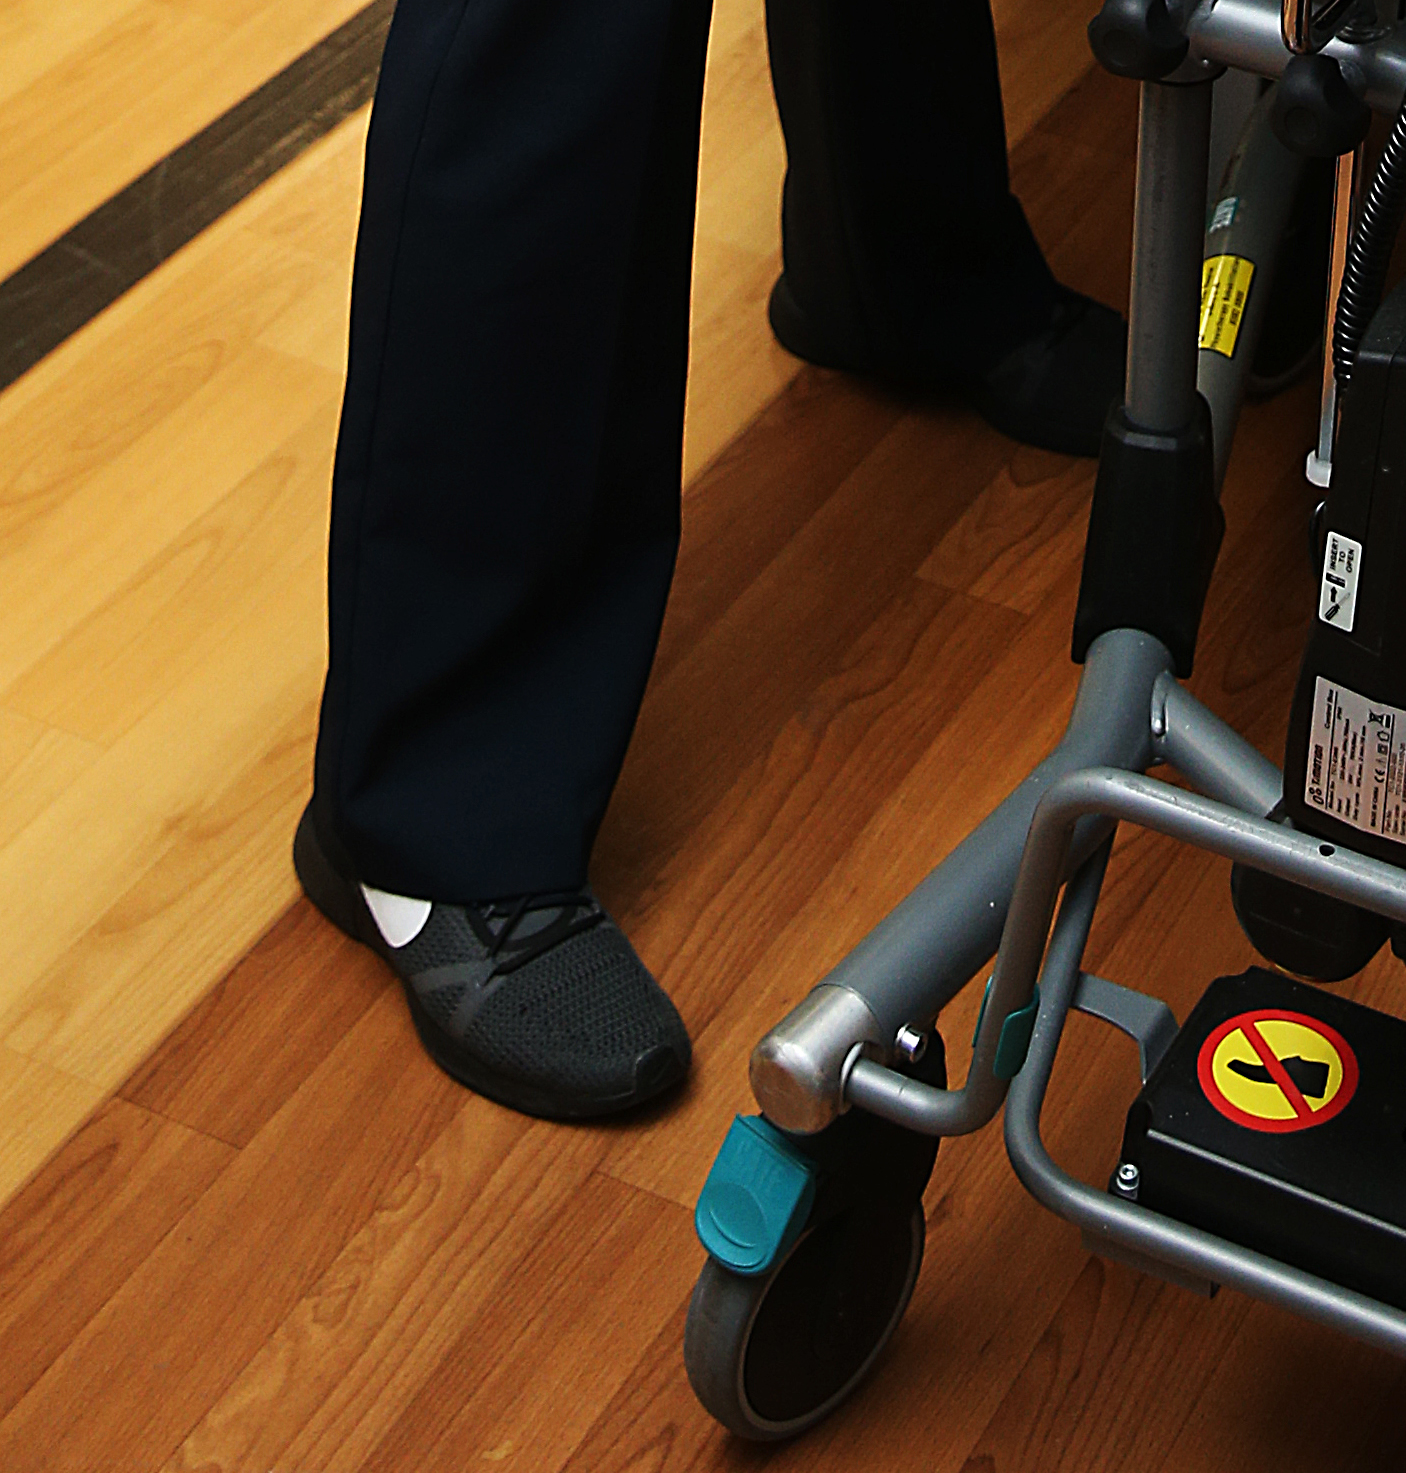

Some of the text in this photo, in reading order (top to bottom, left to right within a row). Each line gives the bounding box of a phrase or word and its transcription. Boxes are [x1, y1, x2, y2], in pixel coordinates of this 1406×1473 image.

[1329, 537, 1338, 570] INSERT
[1338, 550, 1345, 563] TO
[1345, 547, 1354, 573] OPEN
